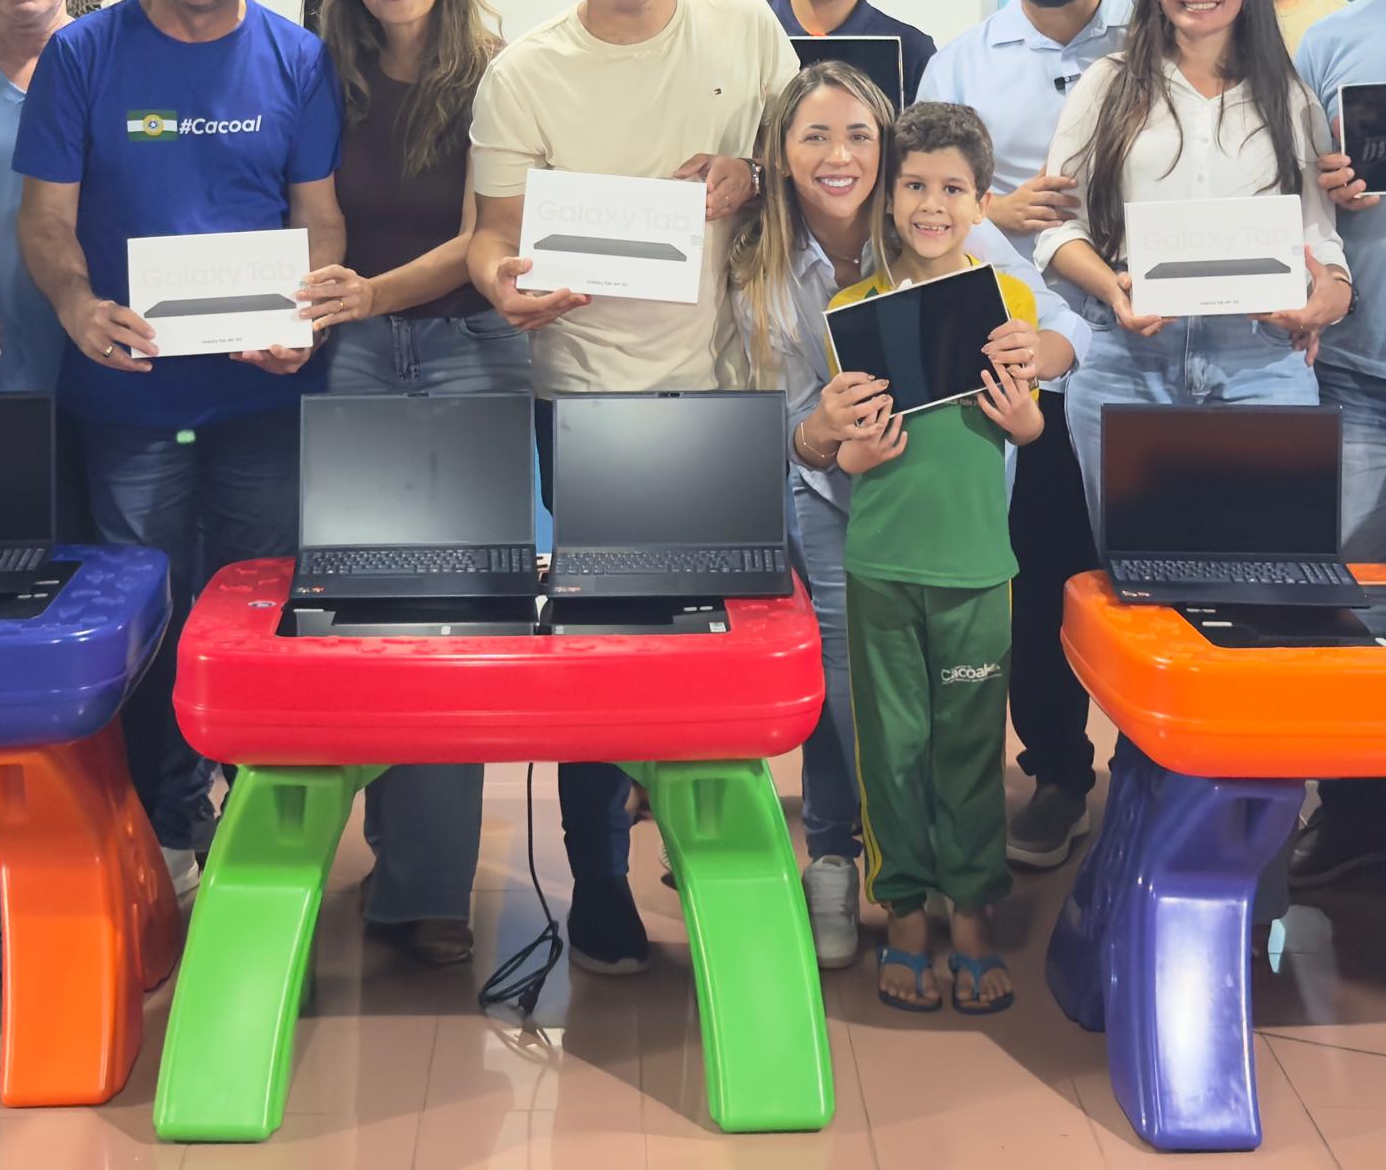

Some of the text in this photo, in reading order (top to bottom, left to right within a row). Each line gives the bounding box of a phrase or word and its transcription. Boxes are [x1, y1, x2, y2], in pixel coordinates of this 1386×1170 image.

[179, 114, 262, 135] #Cacoal
[537, 199, 691, 232] Galaxy Tab
[1143, 221, 1291, 253] Galaxy Tab
[142, 256, 297, 289] Galaxy Tab
